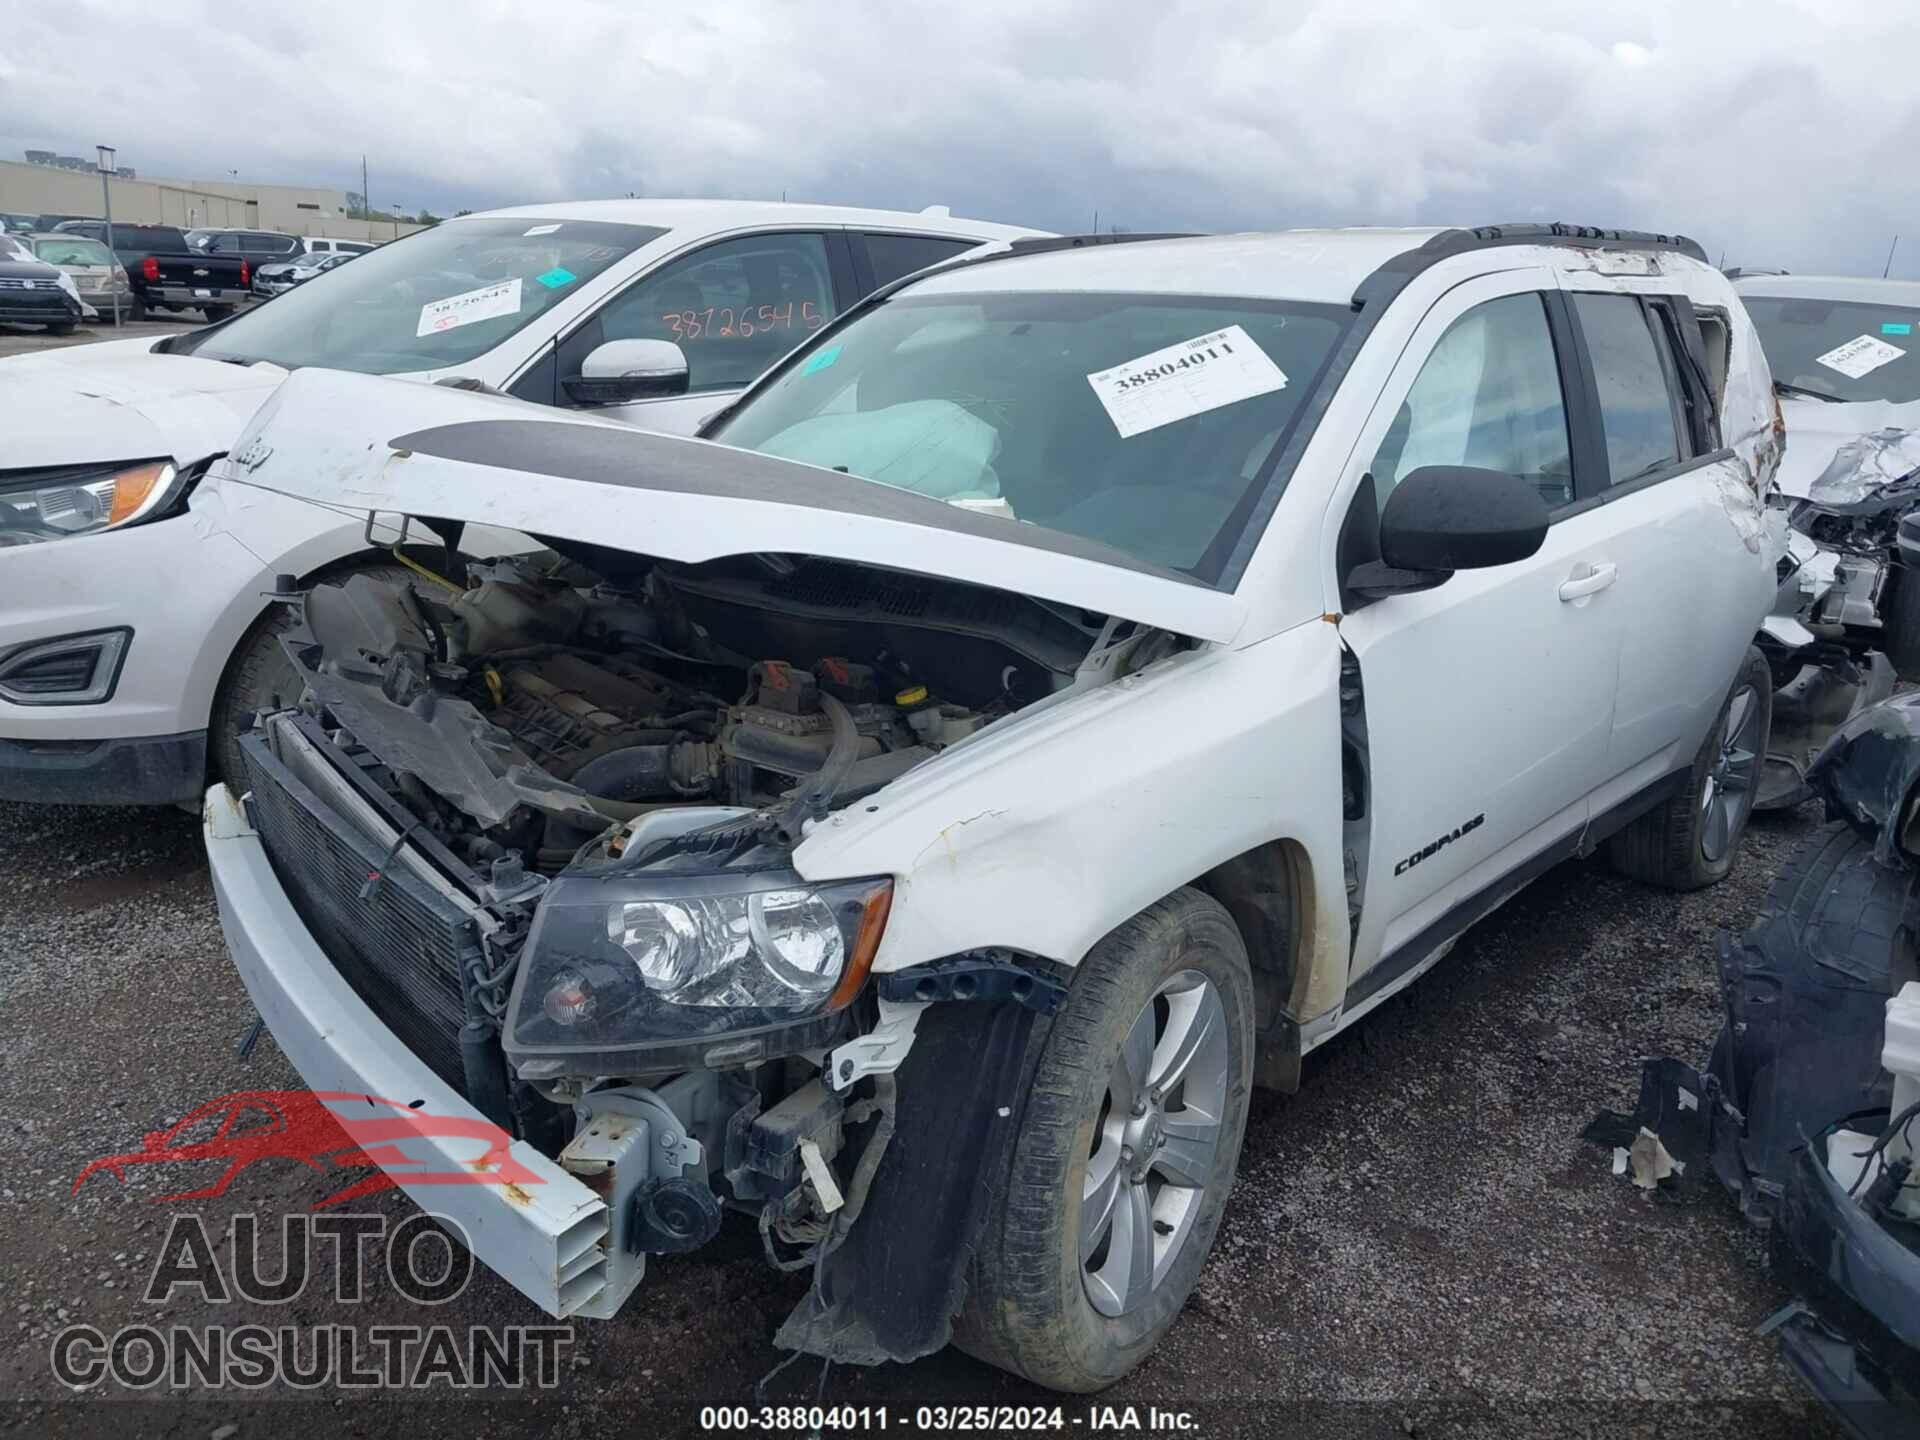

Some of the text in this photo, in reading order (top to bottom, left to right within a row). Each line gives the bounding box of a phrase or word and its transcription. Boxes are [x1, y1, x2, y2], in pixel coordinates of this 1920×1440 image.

[662, 301, 824, 343] 38726545
[1112, 342, 1235, 394] 38804011
[1394, 812, 1485, 877] COMPASS
